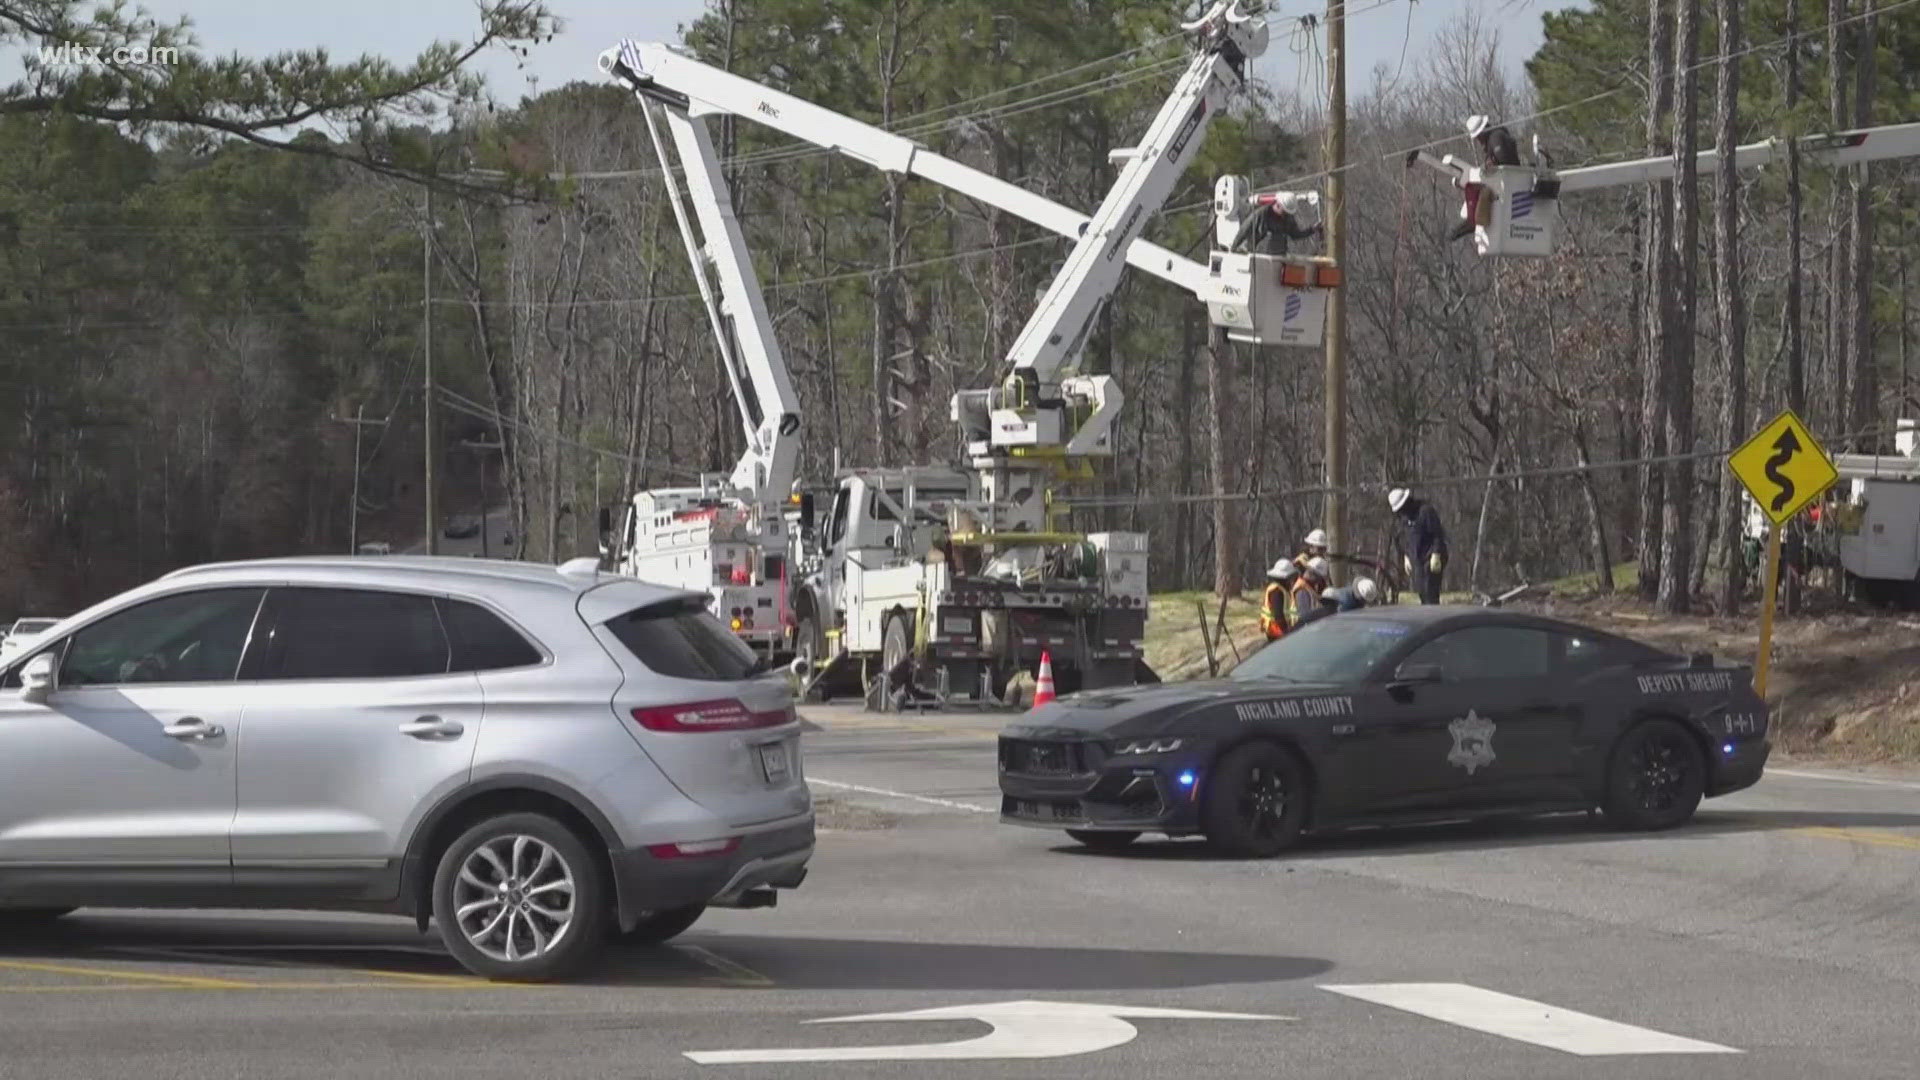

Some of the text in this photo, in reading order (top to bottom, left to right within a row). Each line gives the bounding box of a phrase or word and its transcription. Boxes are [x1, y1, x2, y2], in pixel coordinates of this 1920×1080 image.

[1637, 672, 1732, 694] DEPUTY SHERIFF
[1235, 696, 1354, 721] RICHLAND COUNTY
